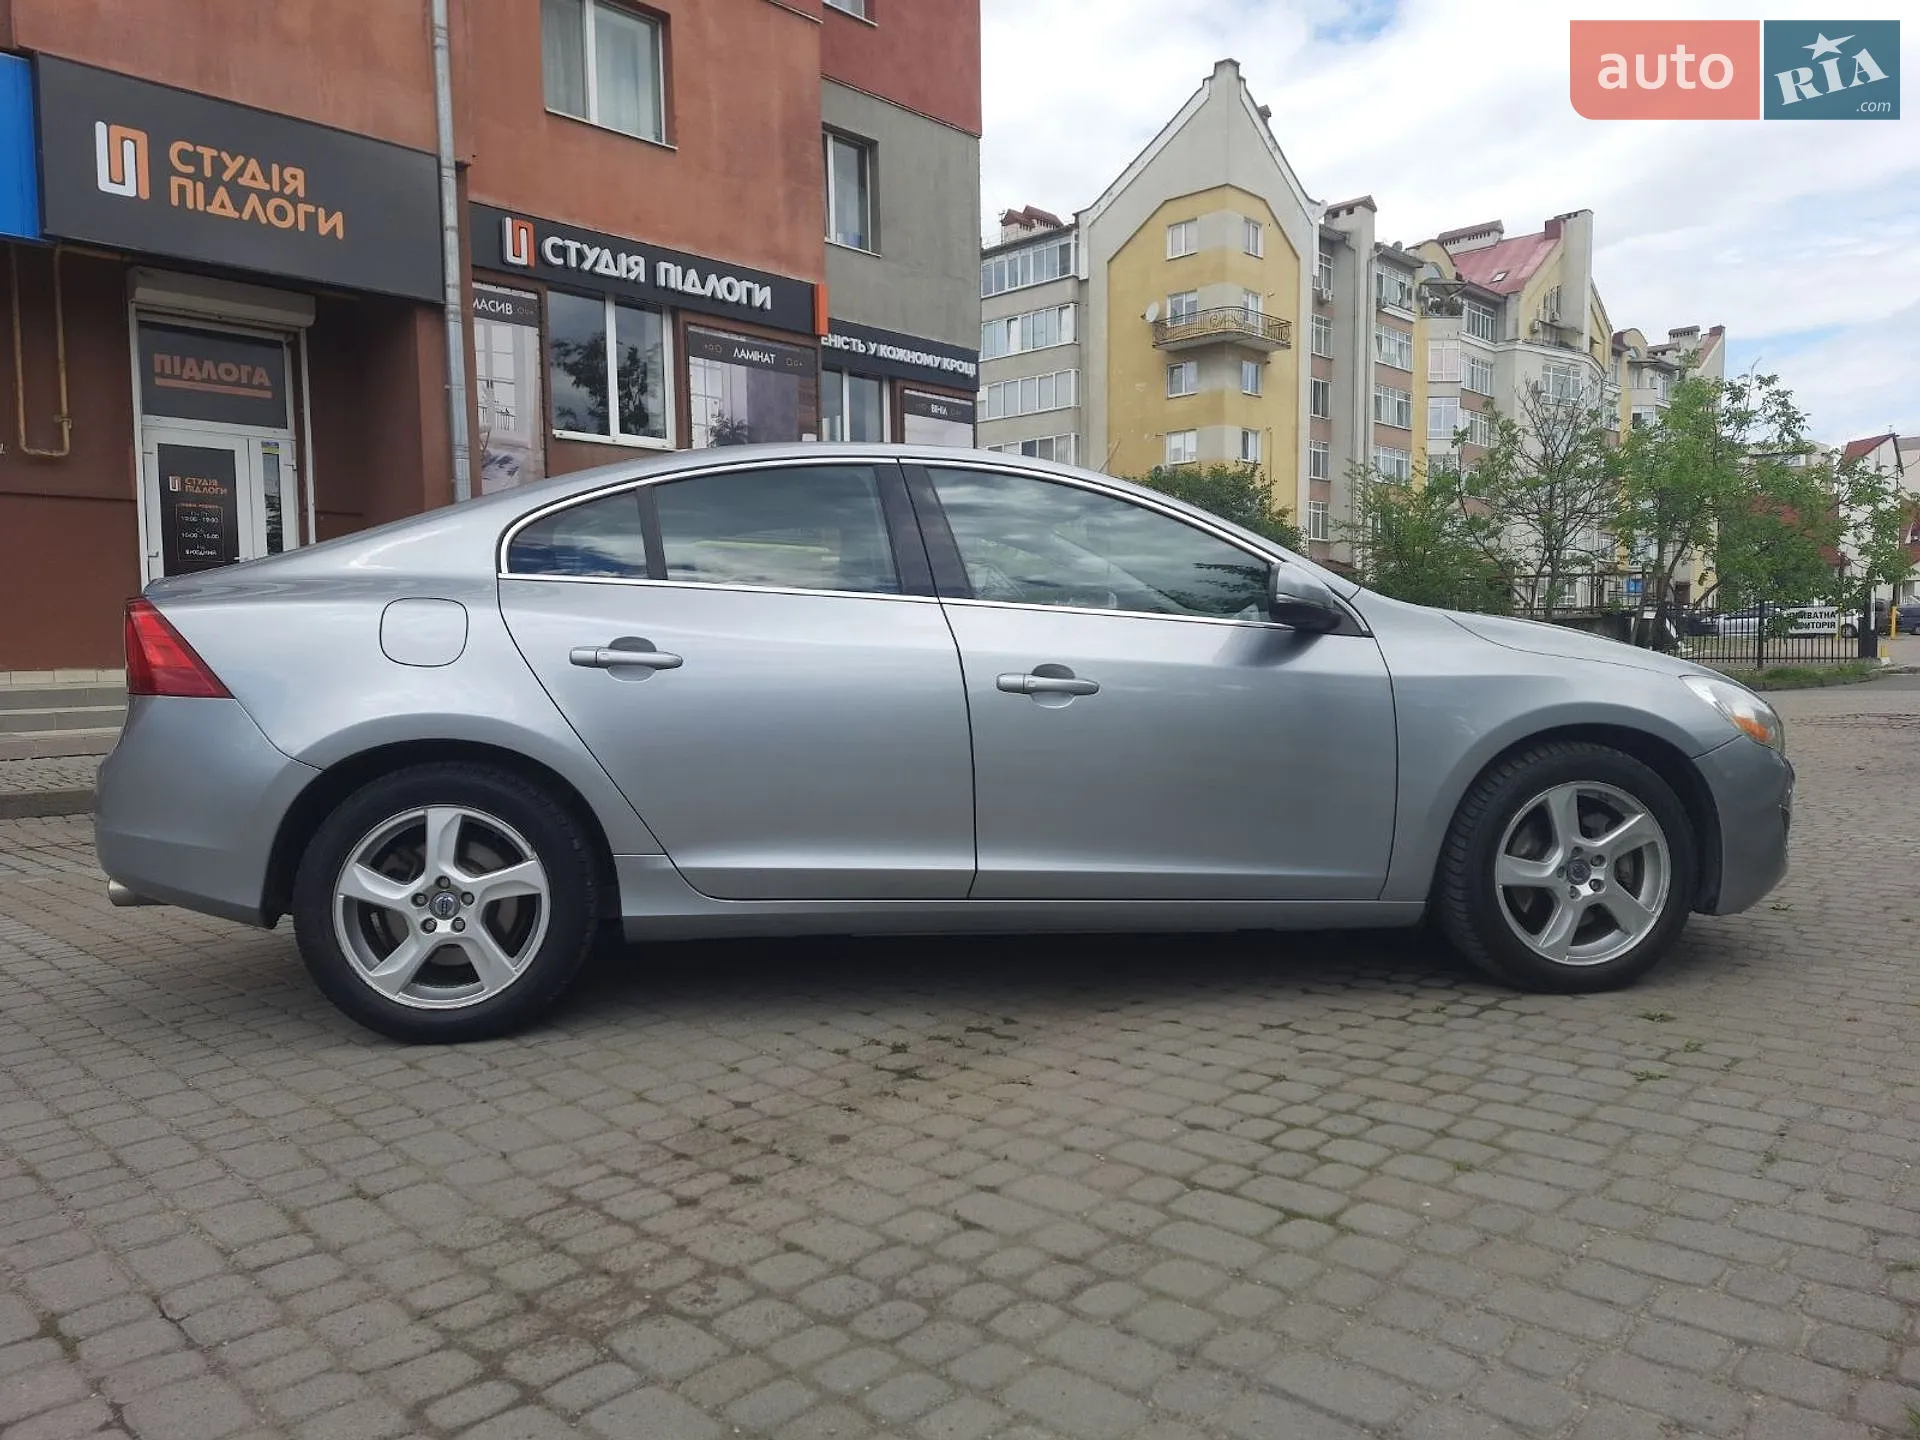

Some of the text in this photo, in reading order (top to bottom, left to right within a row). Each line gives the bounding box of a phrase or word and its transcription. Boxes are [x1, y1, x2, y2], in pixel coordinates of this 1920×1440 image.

[168, 140, 305, 198] СТУДІЯ
[169, 175, 344, 240] ПІДЛОГИ
[541, 236, 772, 310] СТУДІЯ ПІДЛОГИ
[154, 353, 272, 387] ПІДЛОГА
[733, 347, 776, 365] ЛАМІНАТ
[866, 341, 877, 356] У
[877, 344, 942, 368] КОЖНОМУ
